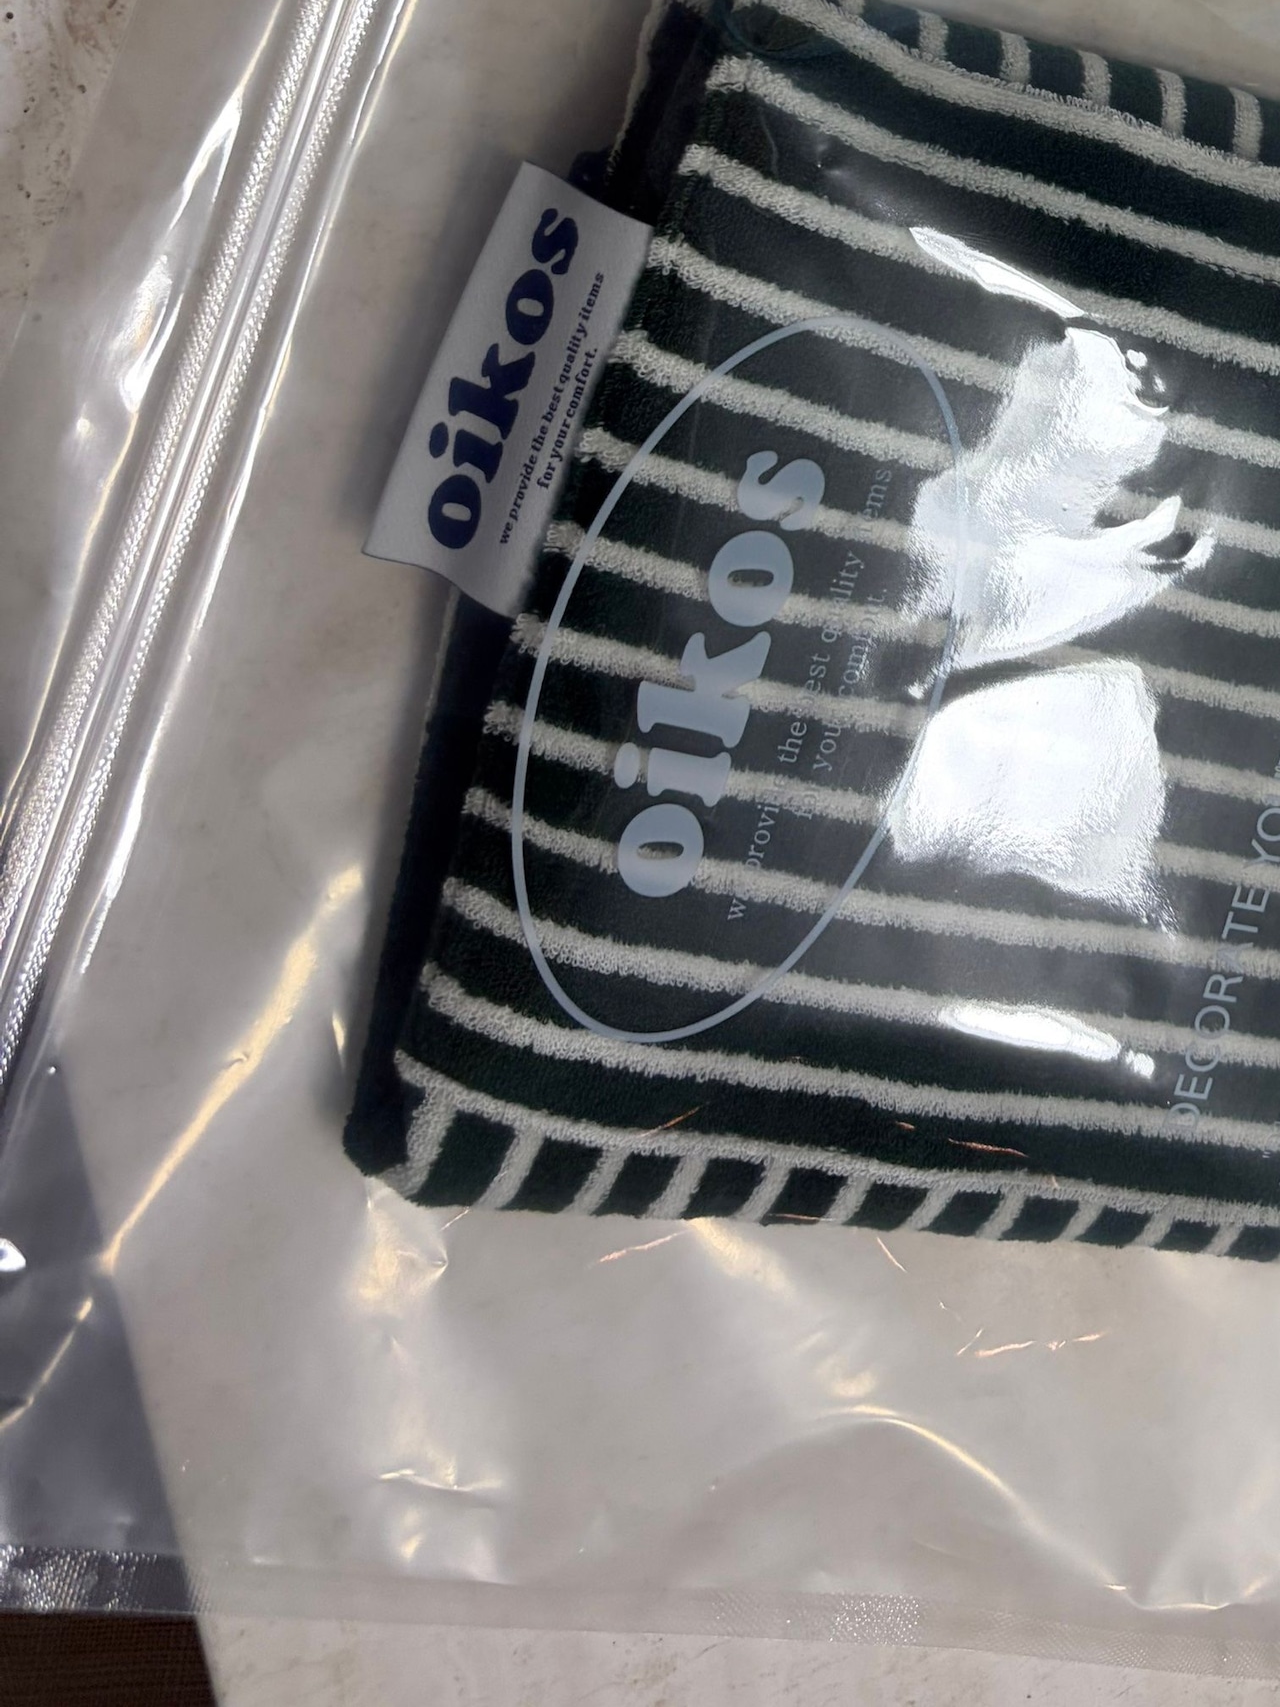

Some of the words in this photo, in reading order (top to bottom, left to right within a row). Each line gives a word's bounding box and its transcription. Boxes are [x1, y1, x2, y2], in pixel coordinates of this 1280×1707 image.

[577, 271, 606, 321] items
[427, 207, 581, 549] oikos
[558, 322, 590, 386] quality
[534, 461, 558, 491] for
[547, 416, 572, 461] your
[565, 347, 600, 419] comfort.
[539, 383, 565, 424] best
[528, 423, 551, 453] the
[508, 452, 538, 521] provide
[497, 519, 516, 546] we
[613, 449, 826, 898] oikos
[776, 718, 810, 765] the
[1167, 884, 1270, 1132] DECORATE
